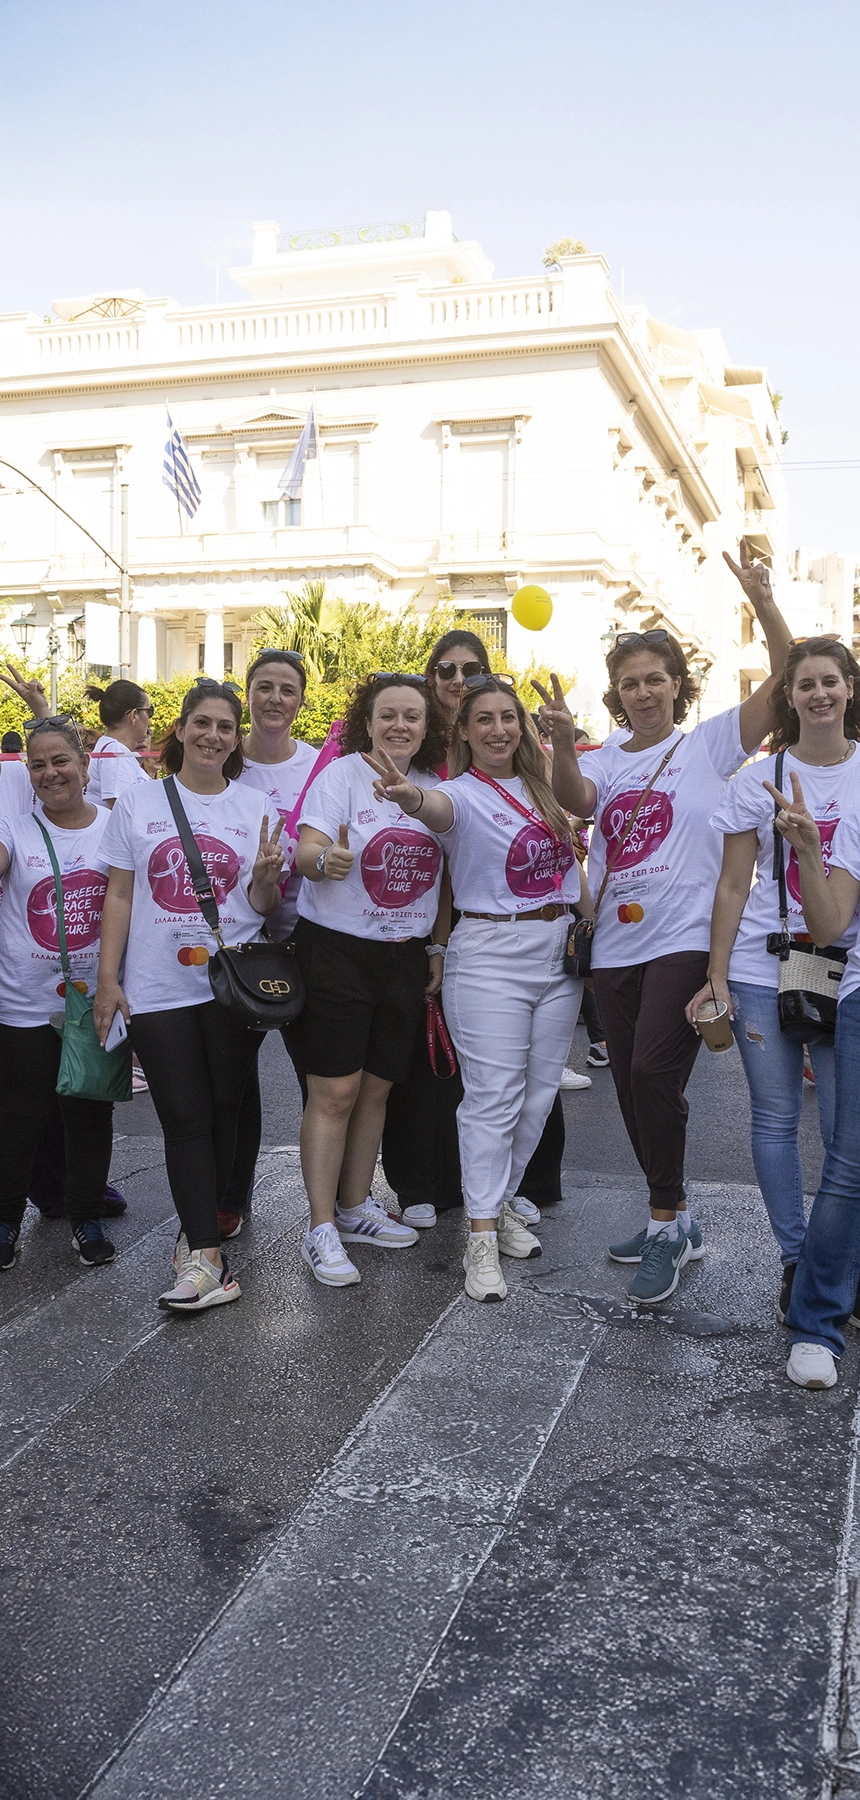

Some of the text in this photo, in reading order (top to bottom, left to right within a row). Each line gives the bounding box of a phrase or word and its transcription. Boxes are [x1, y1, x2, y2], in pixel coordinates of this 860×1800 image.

[394, 844, 434, 857] GREECE
[391, 856, 419, 868] RACE
[388, 868, 431, 881] FOR THE
[534, 867, 556, 880] CURE
[631, 868, 647, 877] ΣΕΠ
[649, 864, 670, 874] 2024
[208, 875, 227, 888] THE
[387, 881, 412, 893] CURE
[64, 885, 106, 901] GREECE
[63, 899, 92, 913] RACE
